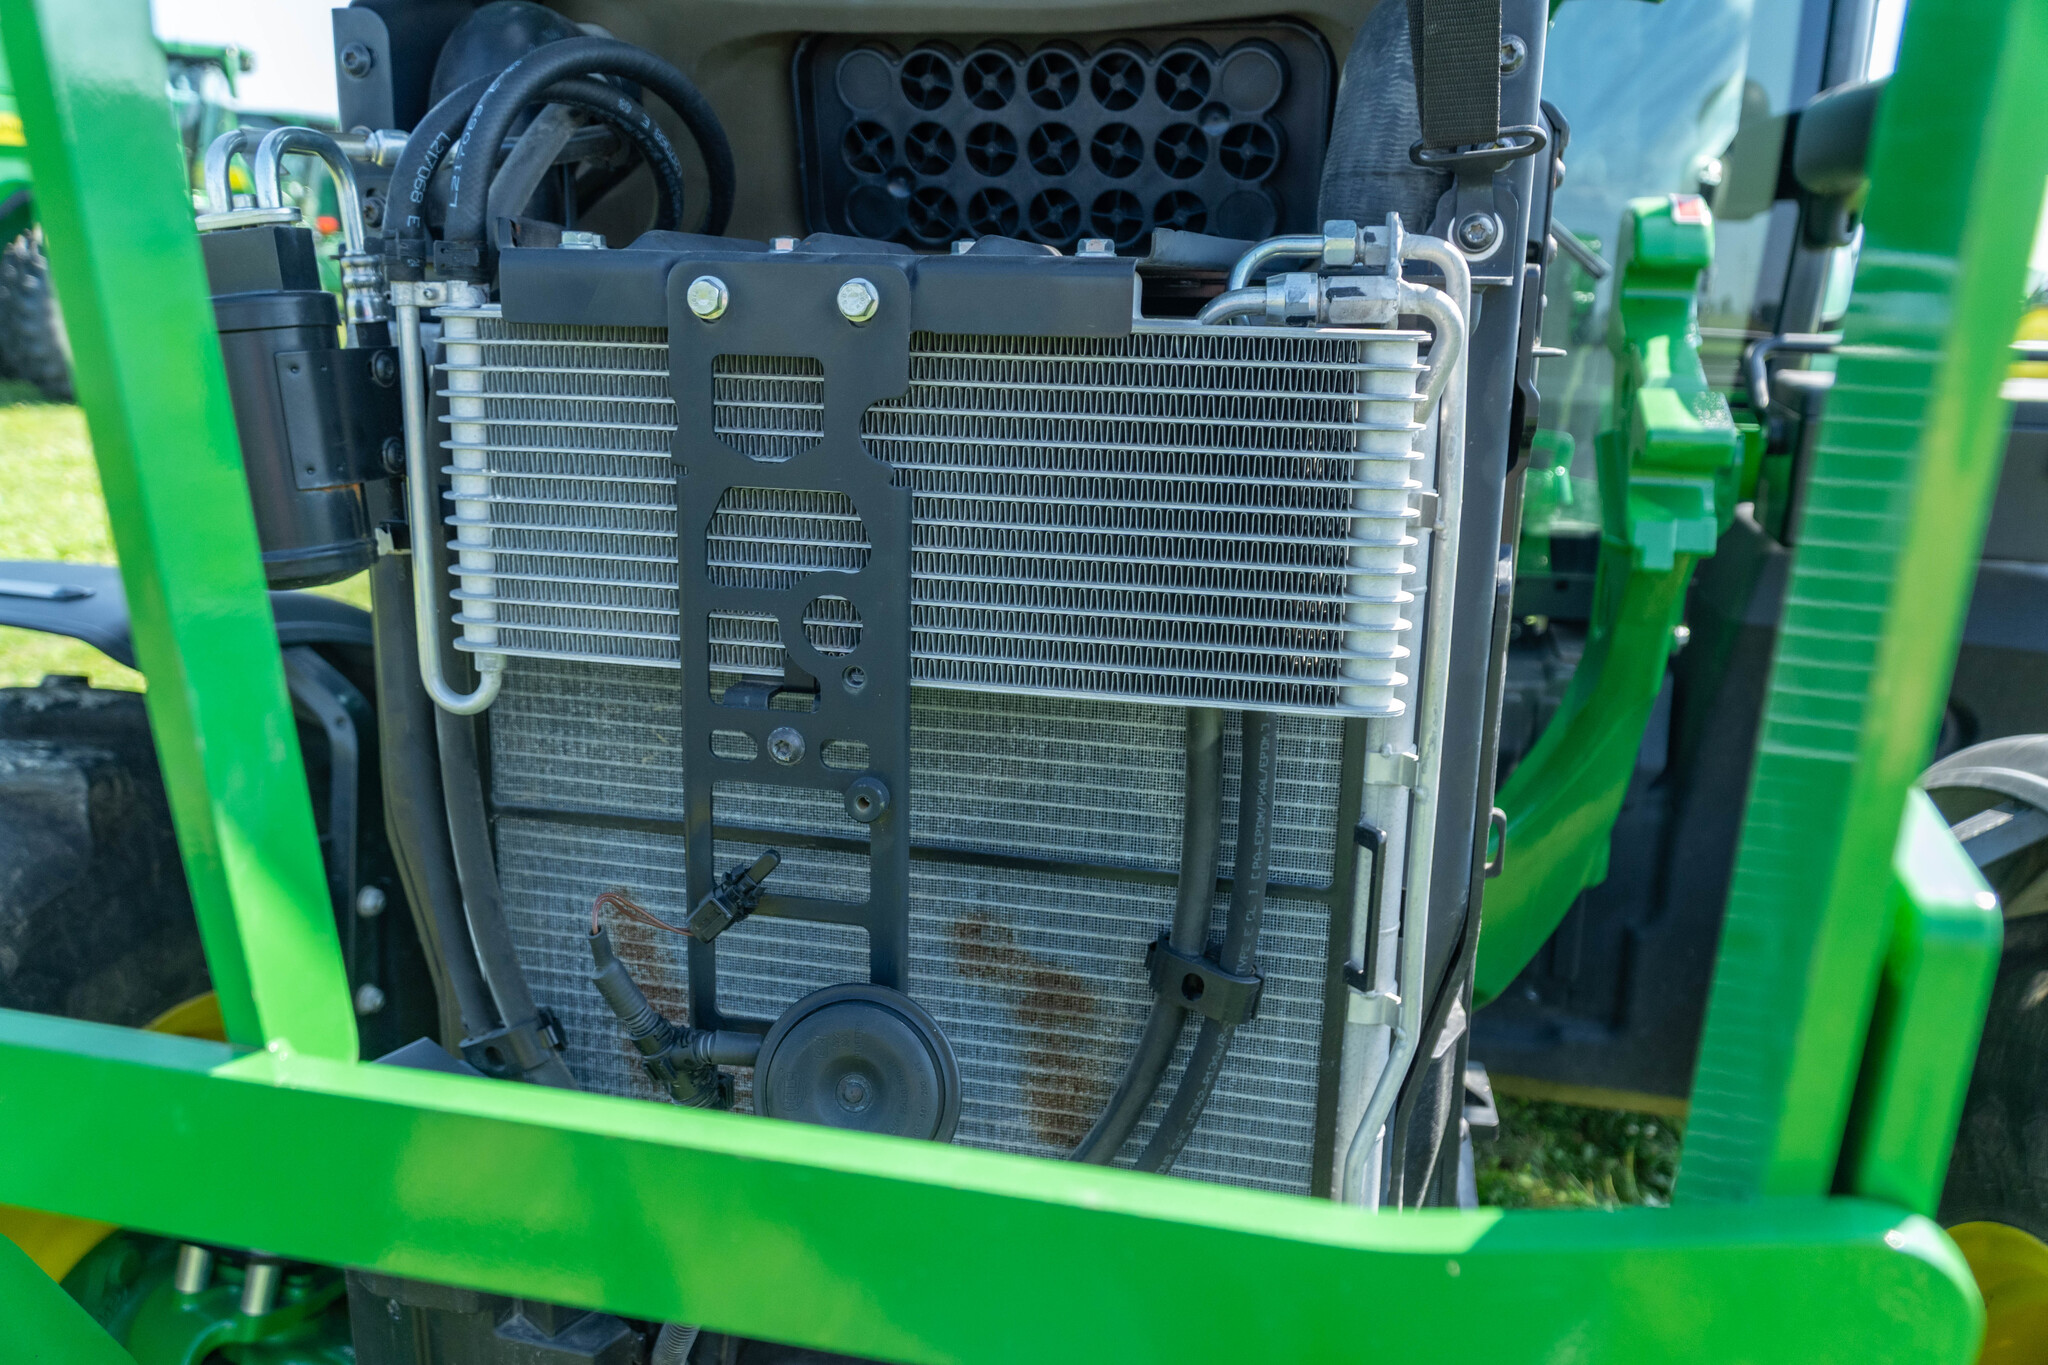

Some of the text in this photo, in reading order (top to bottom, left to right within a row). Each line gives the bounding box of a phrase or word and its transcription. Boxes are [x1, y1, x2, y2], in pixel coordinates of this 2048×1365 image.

[409, 131, 450, 204] L217068
[407, 215, 421, 228] E
[1235, 943, 1251, 974] TYPE
[1244, 926, 1255, 937] E
